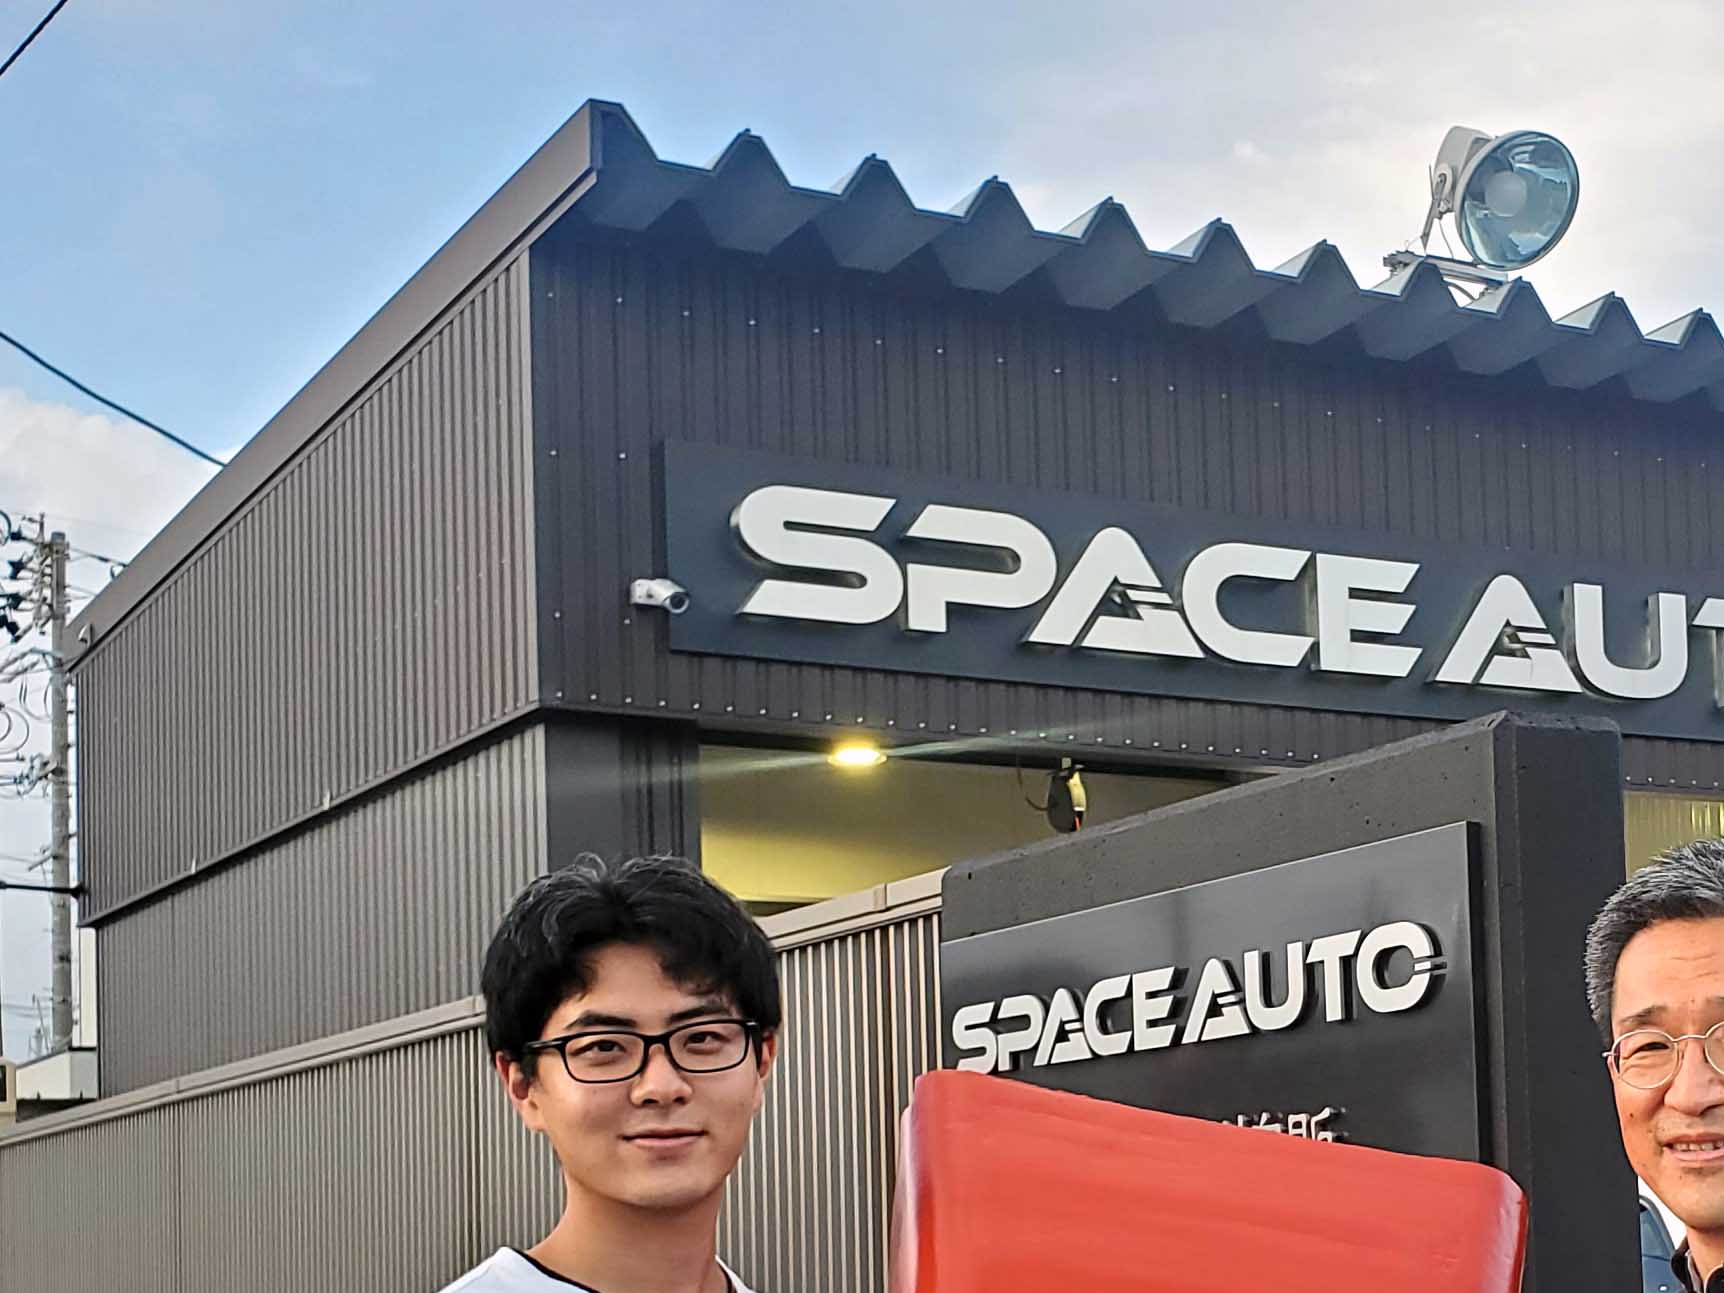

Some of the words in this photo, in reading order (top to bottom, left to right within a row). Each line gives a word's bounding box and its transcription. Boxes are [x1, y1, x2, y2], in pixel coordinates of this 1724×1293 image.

[735, 485, 1422, 677] SPACE
[952, 966, 1178, 1075] SPACE
[1181, 921, 1432, 1044] AUTO
